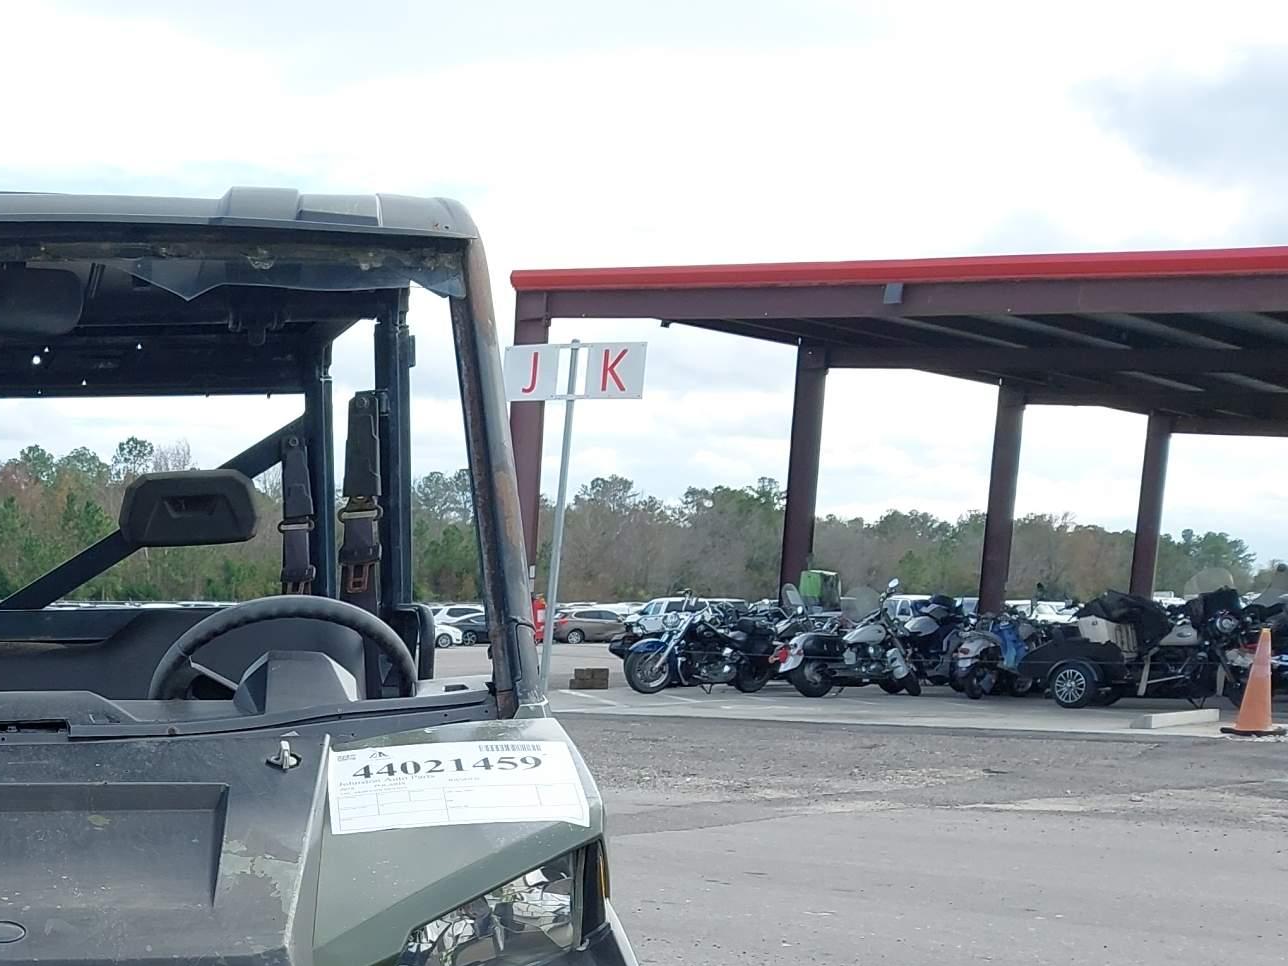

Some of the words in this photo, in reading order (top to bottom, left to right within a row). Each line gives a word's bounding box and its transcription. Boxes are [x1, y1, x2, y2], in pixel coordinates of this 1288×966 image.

[522, 351, 539, 393] J
[601, 349, 629, 392] K
[352, 756, 543, 779] 44021459
